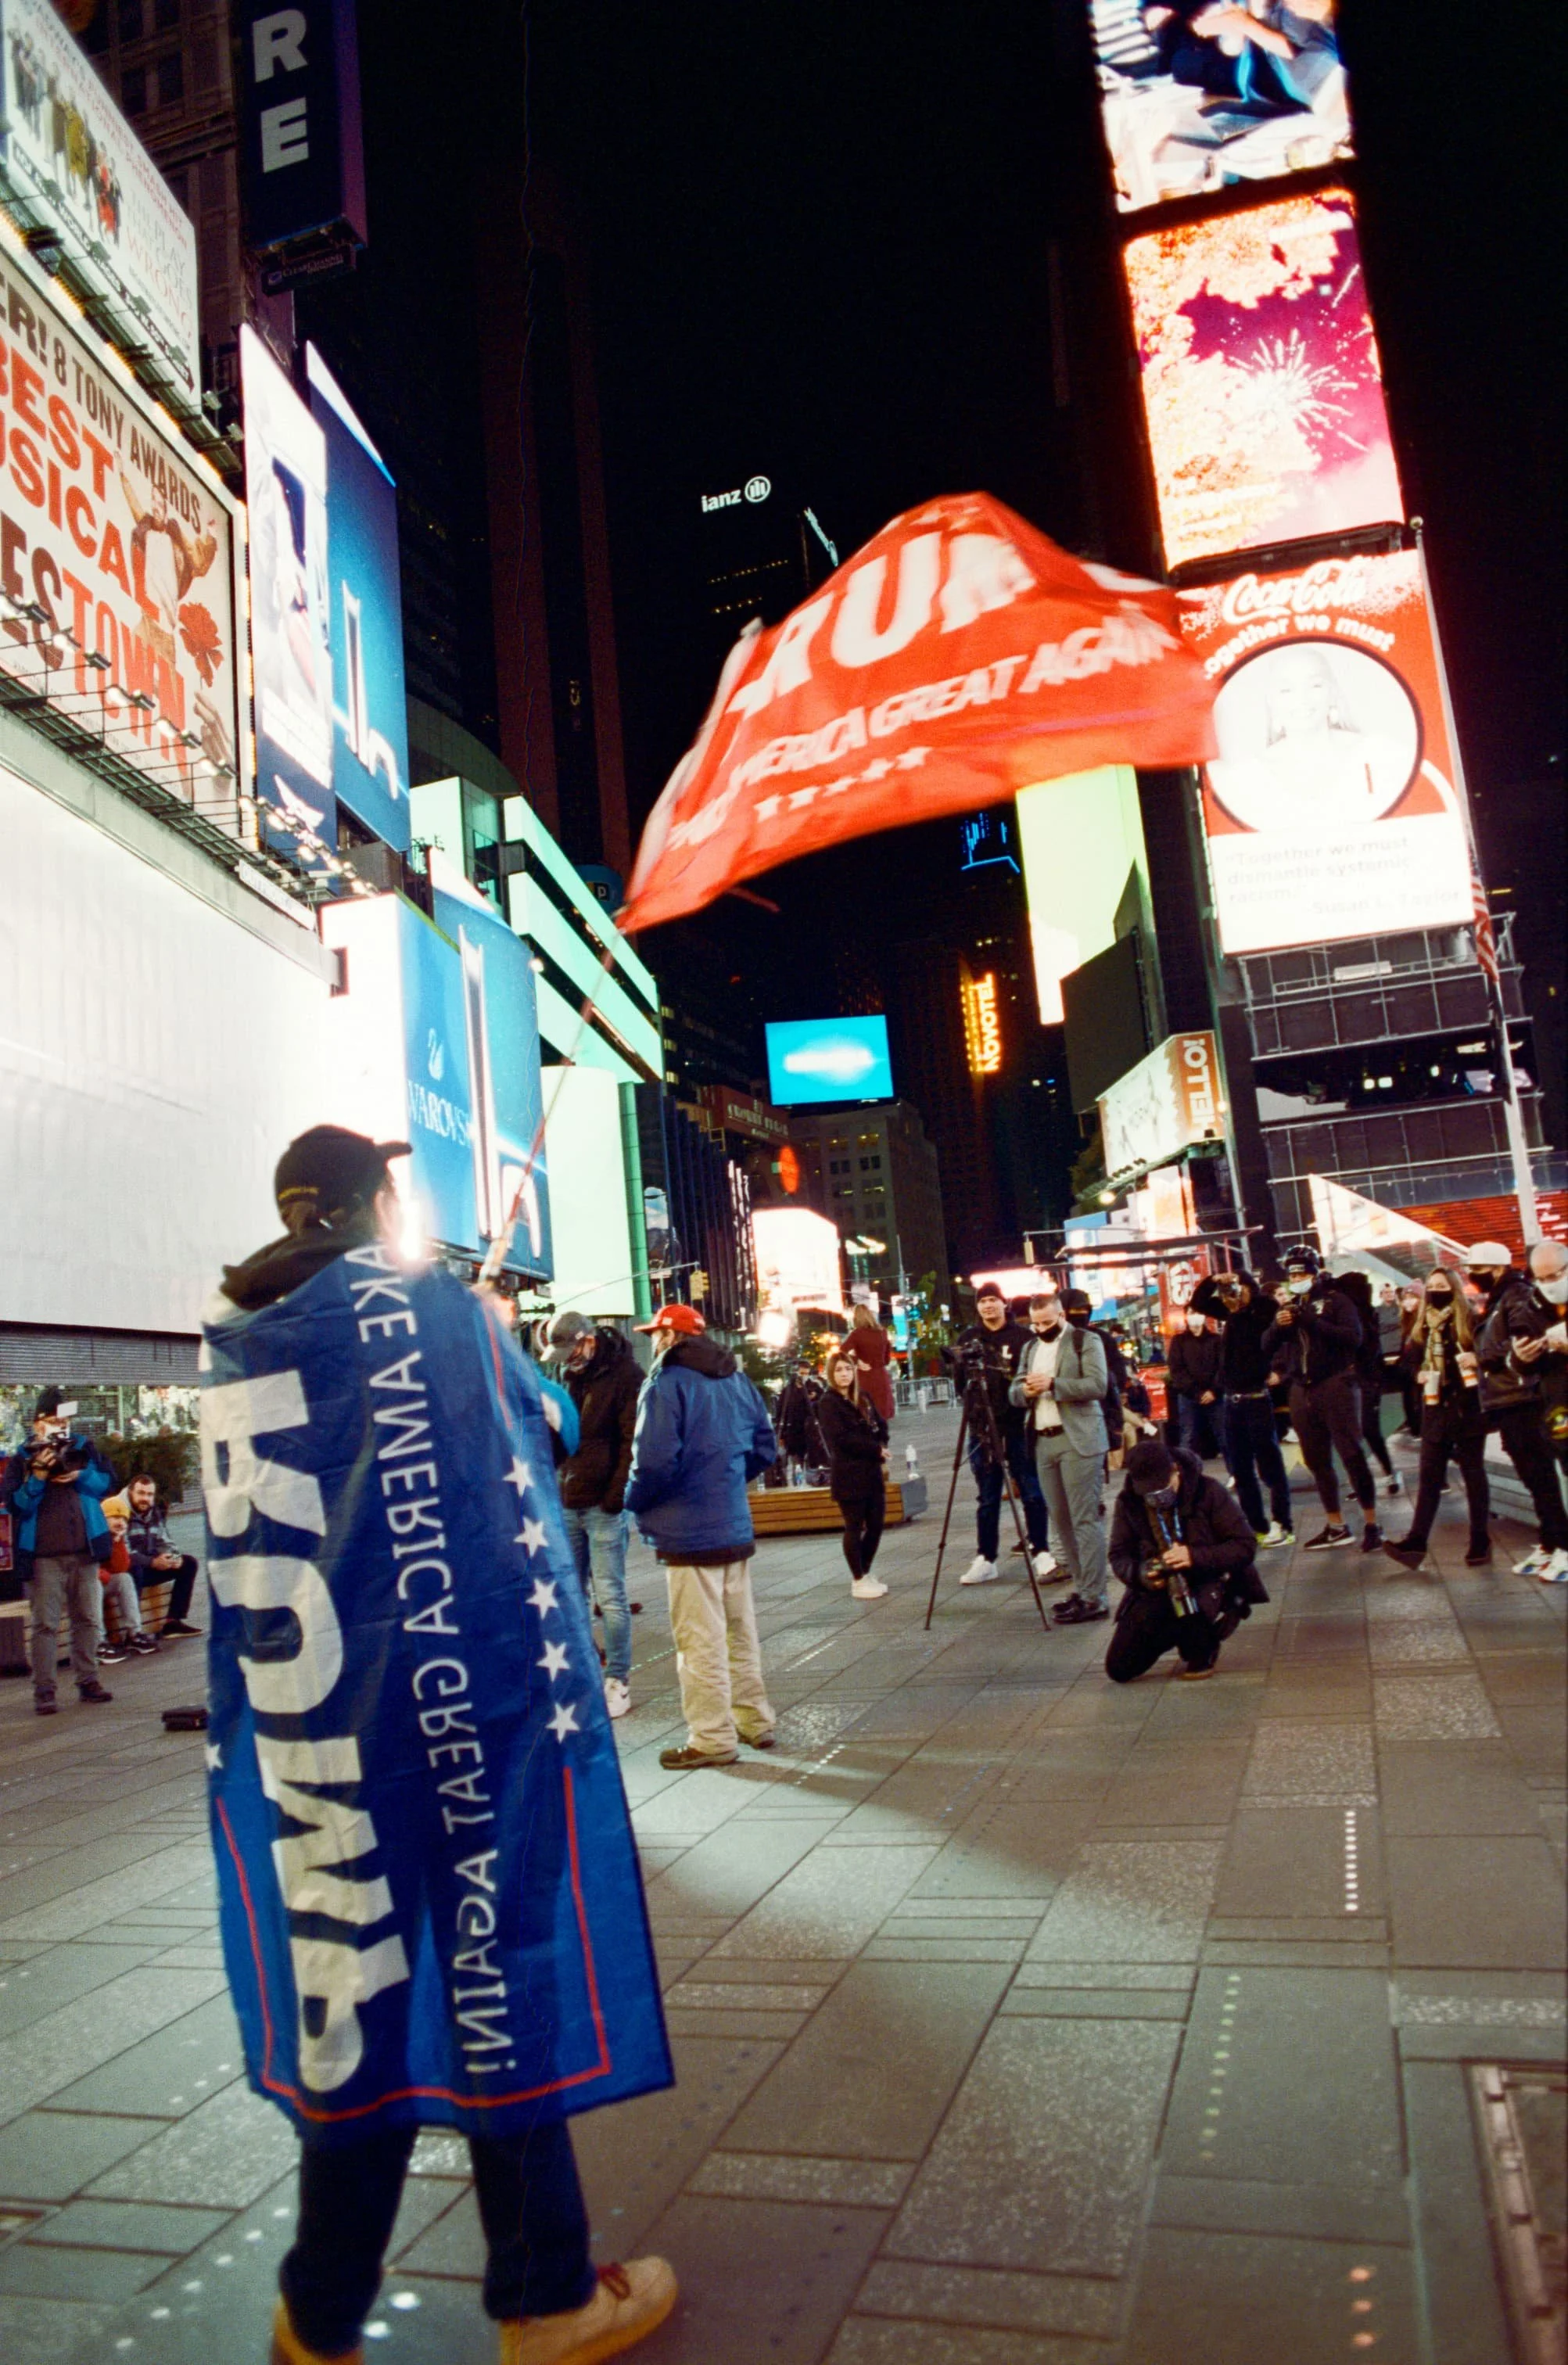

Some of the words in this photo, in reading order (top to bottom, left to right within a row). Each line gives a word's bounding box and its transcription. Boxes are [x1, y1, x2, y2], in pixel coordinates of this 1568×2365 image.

[0, 270, 48, 368] R!
[53, 337, 67, 386] 8
[72, 357, 124, 450] TONY
[130, 425, 202, 534] AWARDS
[0, 409, 160, 623] SICAL
[701, 489, 742, 513] ianz
[1222, 556, 1369, 625] Coca-Cola
[1203, 616, 1290, 680] ogether
[1294, 615, 1331, 632] we
[1334, 618, 1395, 652] must
[868, 654, 1028, 739] GREAT
[1362, 835, 1408, 853] must
[978, 973, 1001, 1071] NOVOTEL
